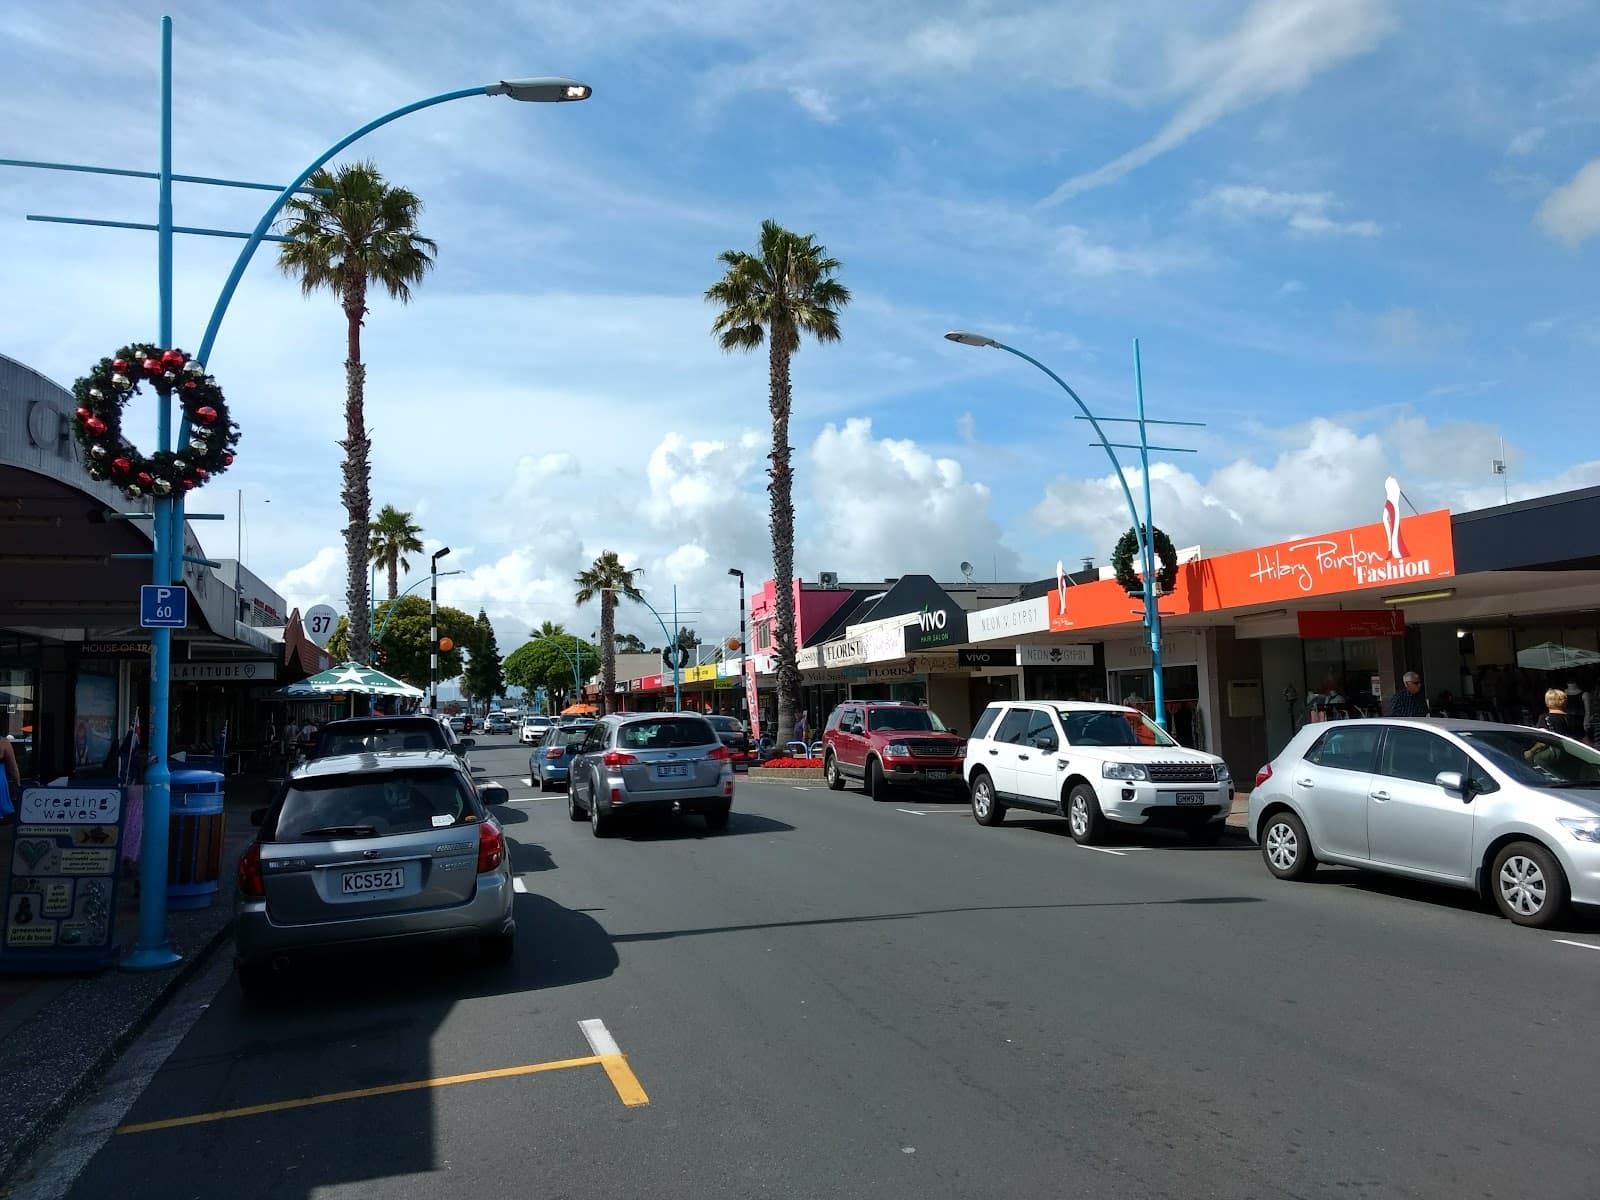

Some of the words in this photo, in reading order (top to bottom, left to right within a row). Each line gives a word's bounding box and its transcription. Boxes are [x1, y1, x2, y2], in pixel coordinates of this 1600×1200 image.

[1250, 550, 1312, 591] Hilary
[1289, 533, 1383, 576] Pointon
[1357, 559, 1430, 584] Fashion
[157, 588, 171, 604] P
[156, 606, 172, 618] 60
[312, 616, 331, 633] 37
[918, 609, 946, 633] VIVO
[827, 640, 862, 660] FLORIST
[966, 653, 990, 662] VIVO
[34, 797, 108, 810] creating
[43, 810, 97, 819] waves
[344, 871, 401, 891] KCS521
